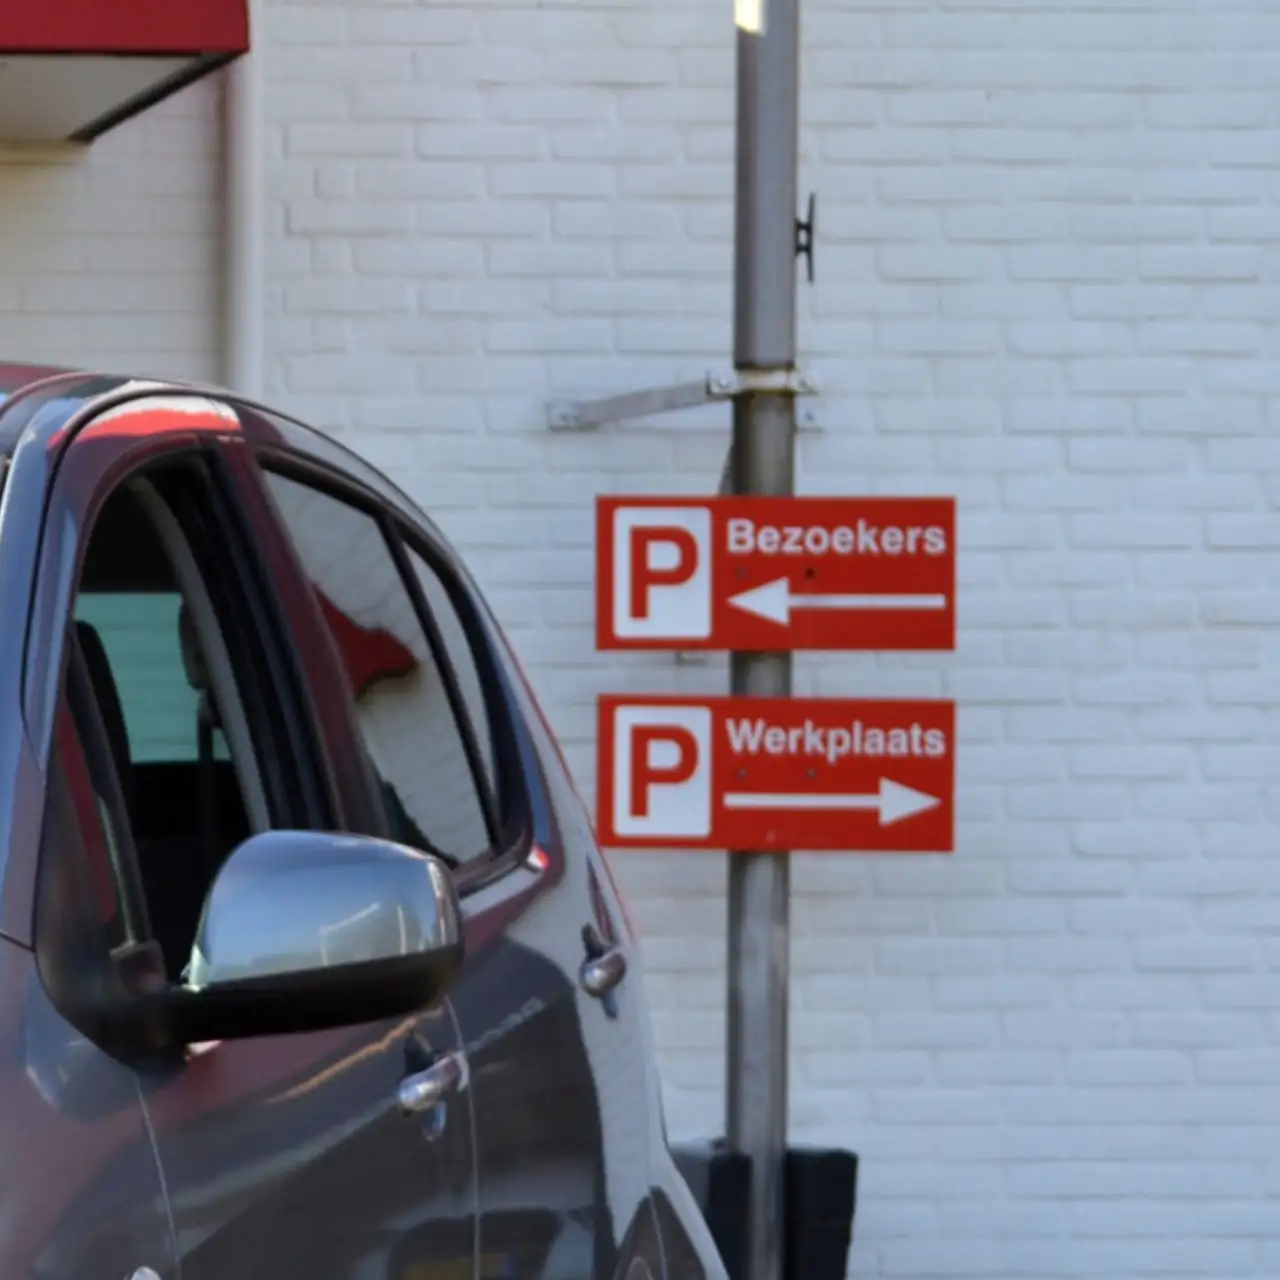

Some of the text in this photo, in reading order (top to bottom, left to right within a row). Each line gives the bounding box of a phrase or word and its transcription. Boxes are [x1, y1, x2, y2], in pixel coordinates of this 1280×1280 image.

[726, 517, 947, 555] Bezoekers
[629, 524, 699, 620] P
[629, 723, 700, 818] P
[725, 717, 946, 764] Werkplaats
